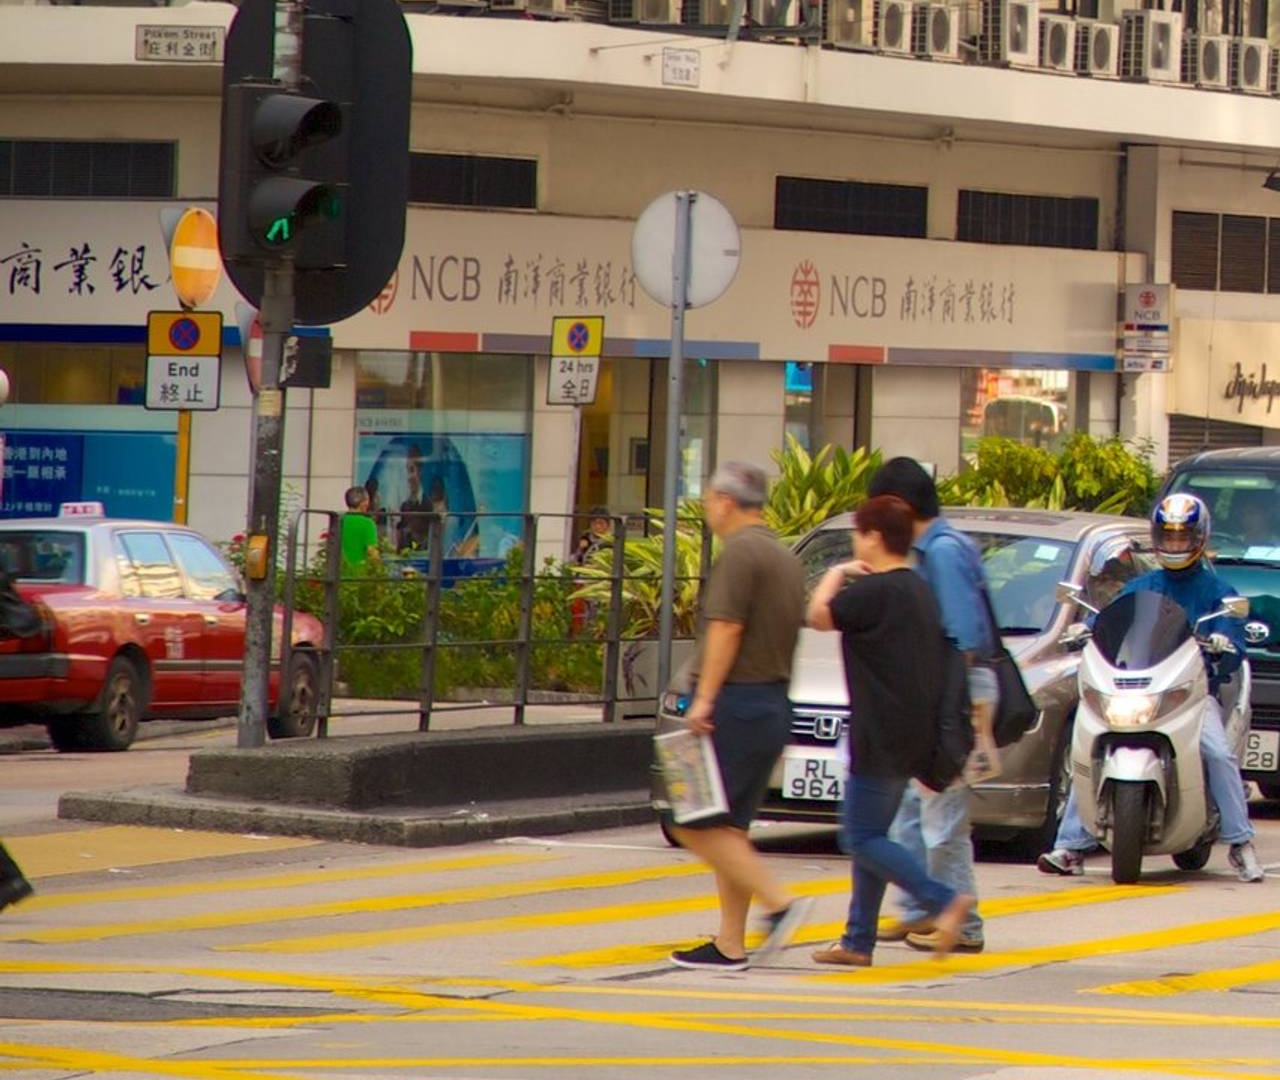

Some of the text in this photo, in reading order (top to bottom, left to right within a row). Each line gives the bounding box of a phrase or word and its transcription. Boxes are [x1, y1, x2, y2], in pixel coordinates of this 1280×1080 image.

[183, 29, 216, 39] Street
[0, 242, 171, 296] 商業銀
[411, 255, 481, 301] NCB
[829, 275, 887, 319] NCB
[1134, 309, 1161, 321] NCB
[167, 362, 199, 378] End
[560, 360, 593, 373] 24 hrs
[160, 384, 203, 403] 終止
[561, 379, 589, 401] 全日
[1246, 734, 1261, 751] G
[805, 759, 836, 779] RL
[1246, 751, 1275, 769] 28
[791, 778, 841, 799] 964
